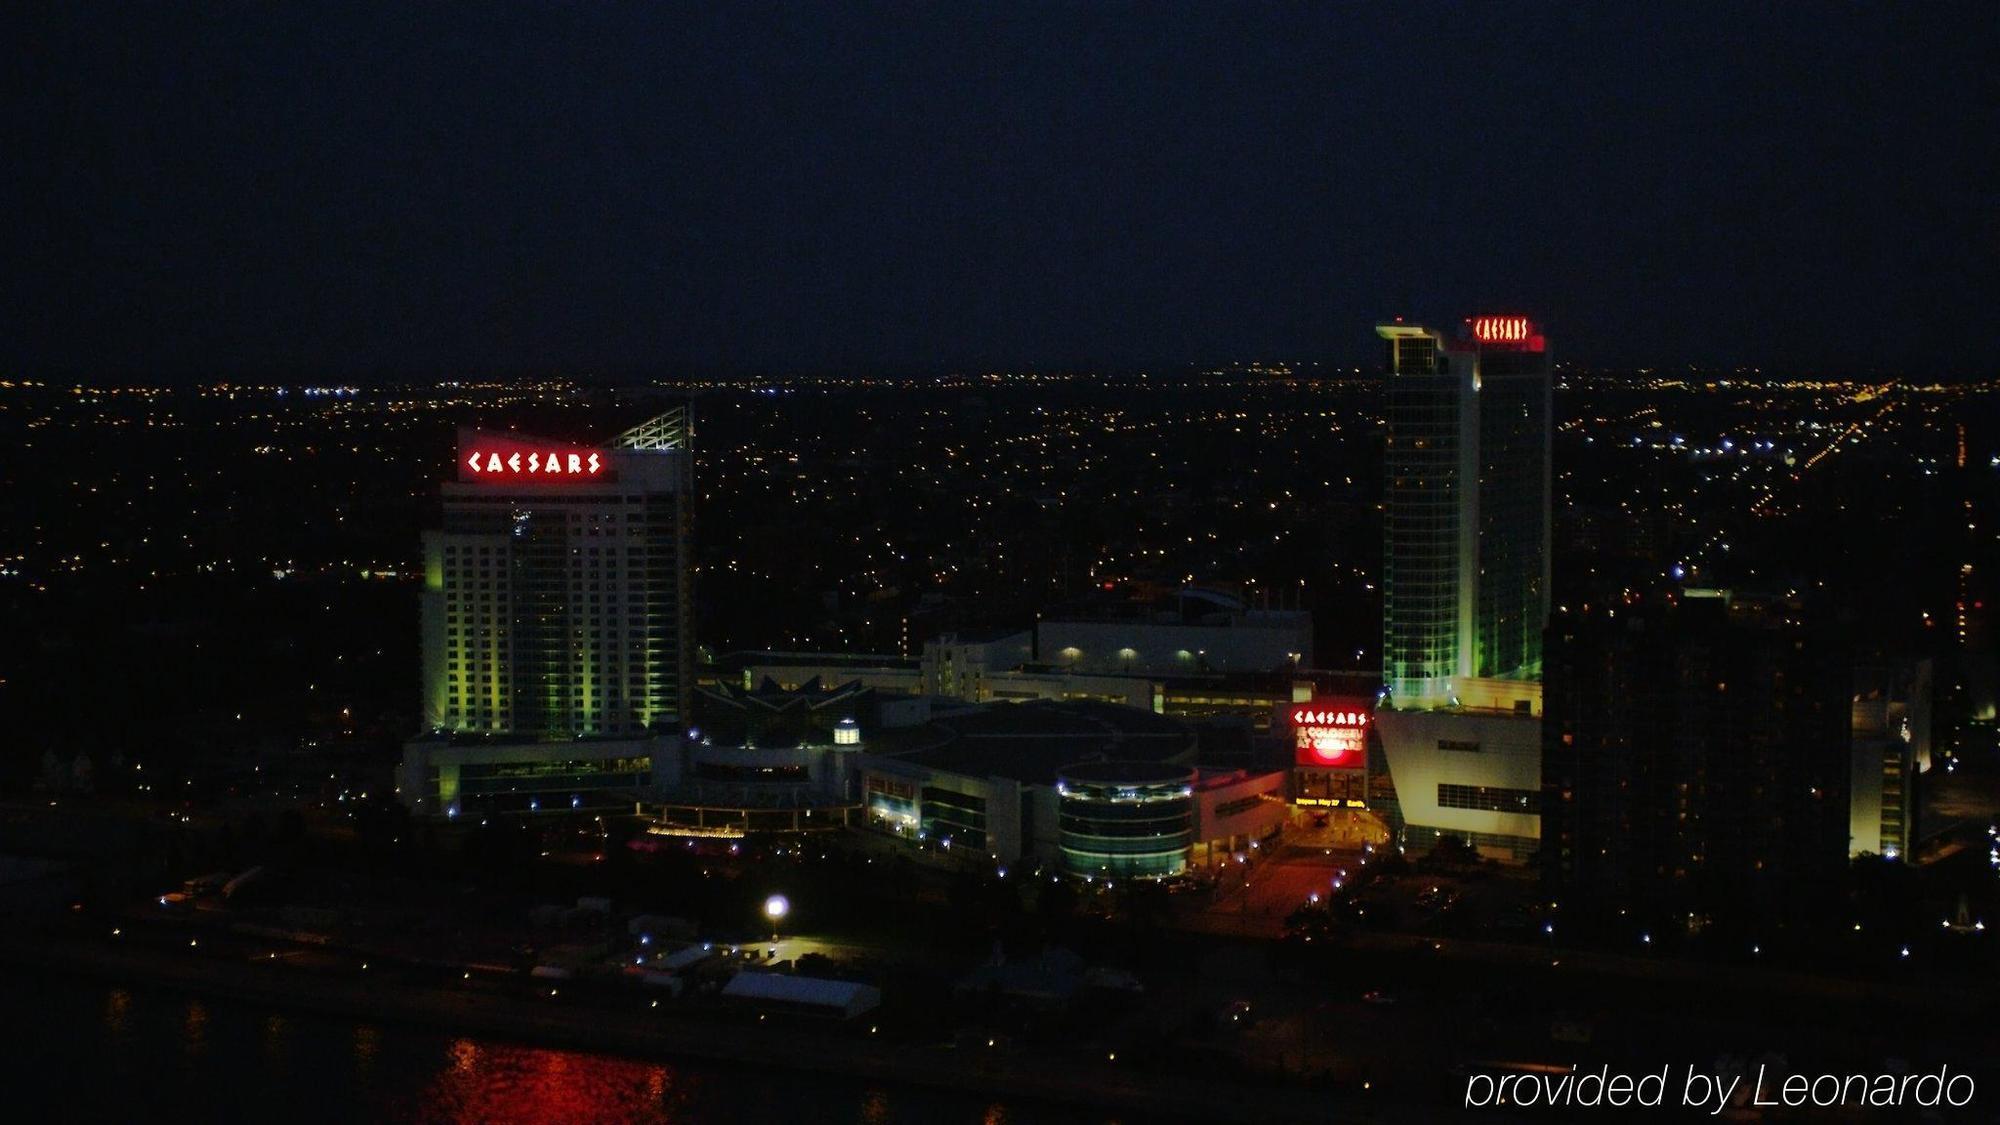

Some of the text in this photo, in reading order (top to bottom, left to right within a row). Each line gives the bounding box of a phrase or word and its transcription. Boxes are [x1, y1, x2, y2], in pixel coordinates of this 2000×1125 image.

[1475, 318, 1527, 340] CAESARS
[468, 451, 601, 474] CAESARS
[1295, 710, 1367, 726] CAESARS
